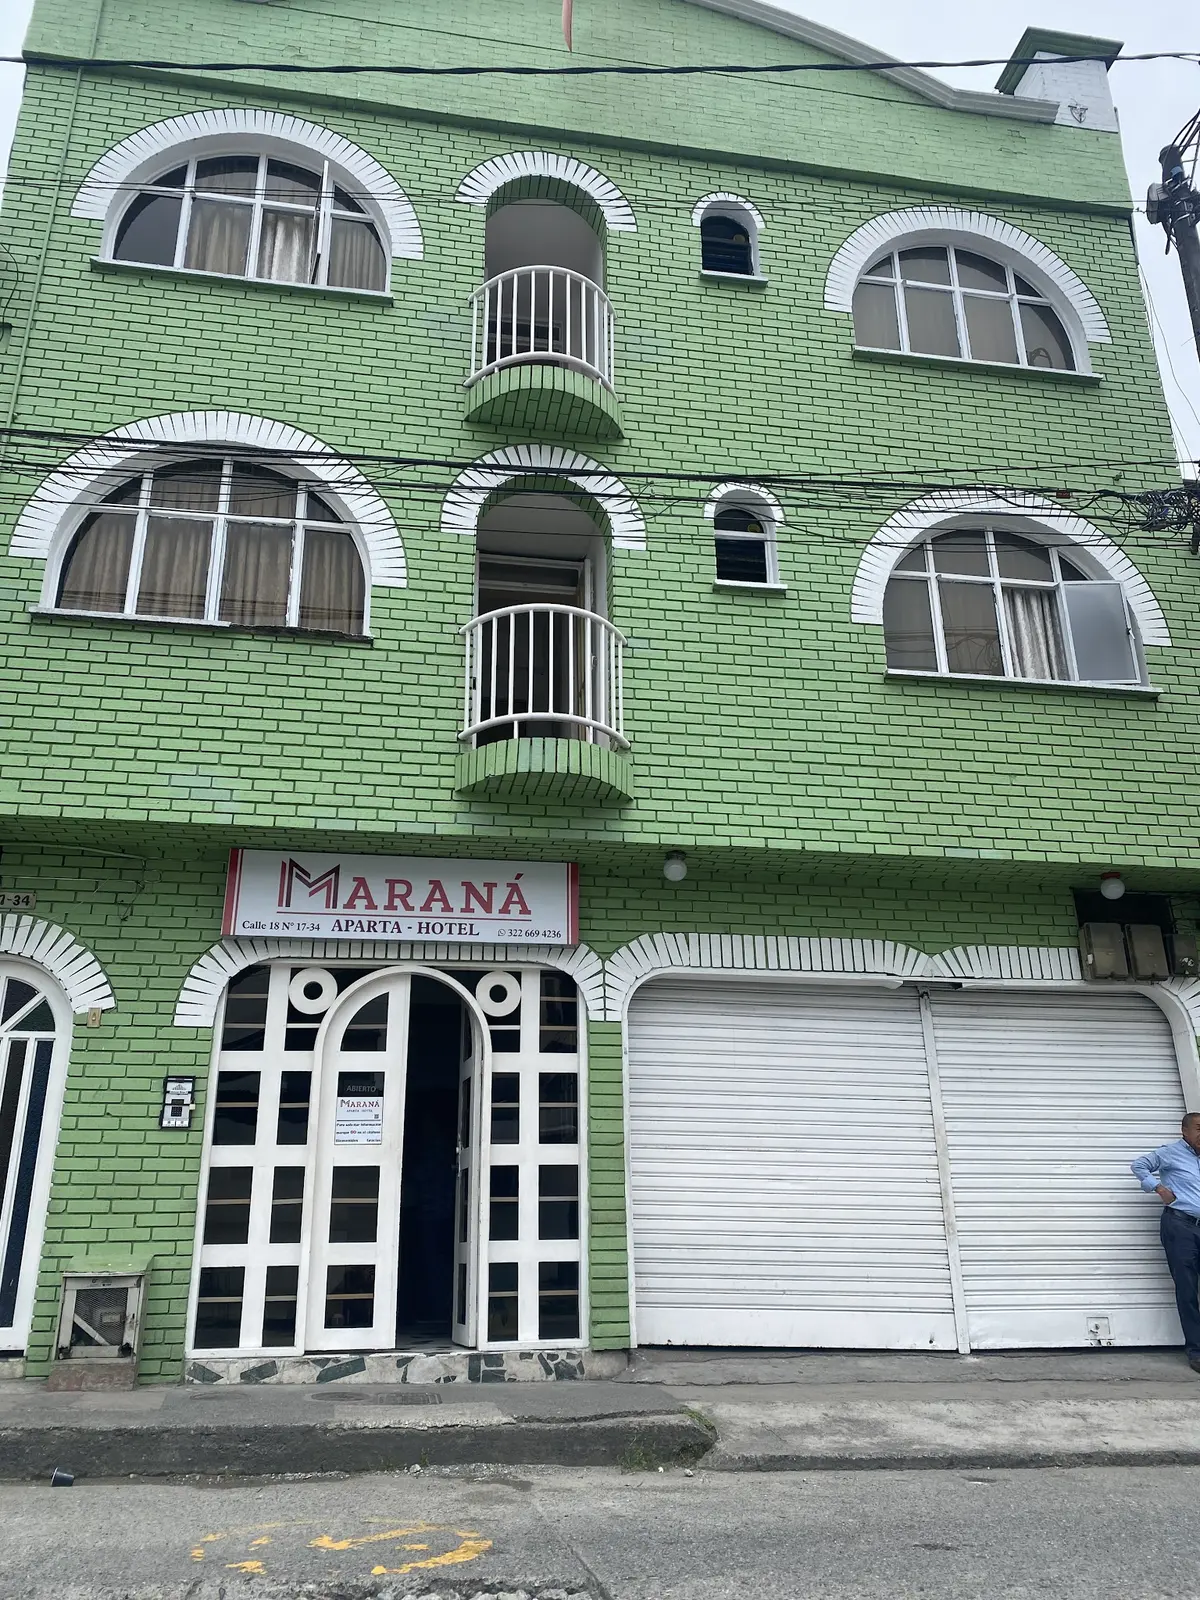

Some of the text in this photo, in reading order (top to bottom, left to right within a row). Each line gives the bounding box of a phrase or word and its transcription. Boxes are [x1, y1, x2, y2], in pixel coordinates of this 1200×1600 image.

[278, 858, 532, 915] MARANÁ
[242, 920, 267, 930] Calle
[269, 921, 280, 930] 18
[296, 922, 320, 932] 17-34
[331, 919, 402, 934] APARTA
[417, 921, 480, 936] HOTEL
[507, 928, 562, 939] 322 669 4236
[340, 1099, 380, 1107] MARANÁ
